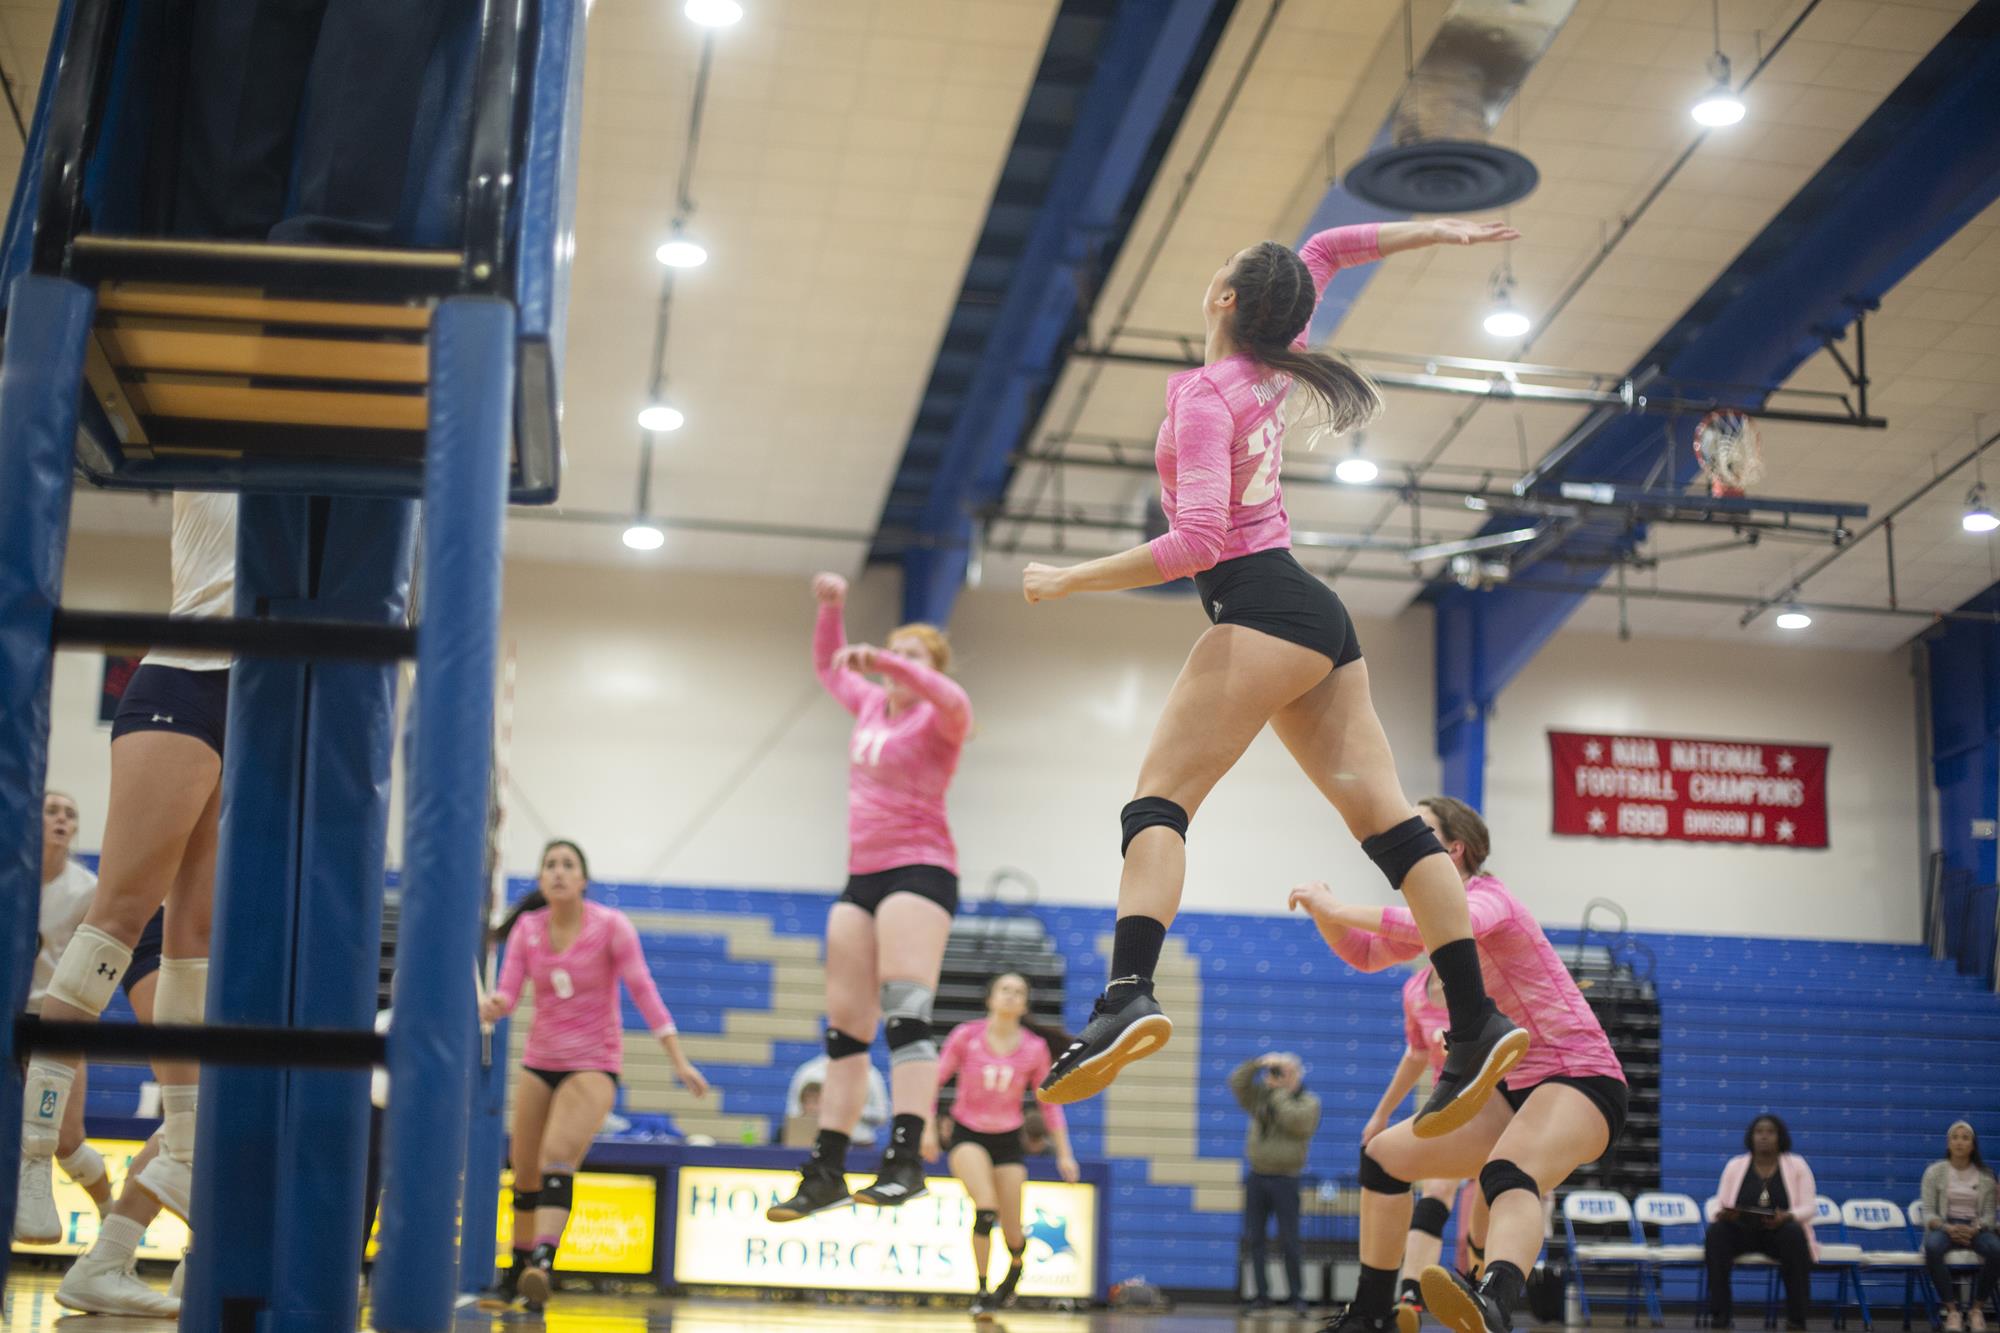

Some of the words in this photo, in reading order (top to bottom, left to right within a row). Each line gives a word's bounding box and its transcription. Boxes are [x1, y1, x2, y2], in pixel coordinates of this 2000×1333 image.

[1611, 738, 1660, 768] NAIA
[1670, 741, 1767, 775] NATIONAL
[1576, 766, 1677, 800] FOOTBALL
[1689, 773, 1804, 807] CHAMPIONS
[1683, 809, 1748, 836] DIVISION
[1752, 812, 1765, 837] II
[1578, 1199, 1616, 1215] PERU
[1648, 1200, 1685, 1217] PERU
[1854, 1206, 1891, 1222] PERU
[744, 1236, 955, 1278] BOBCATS
